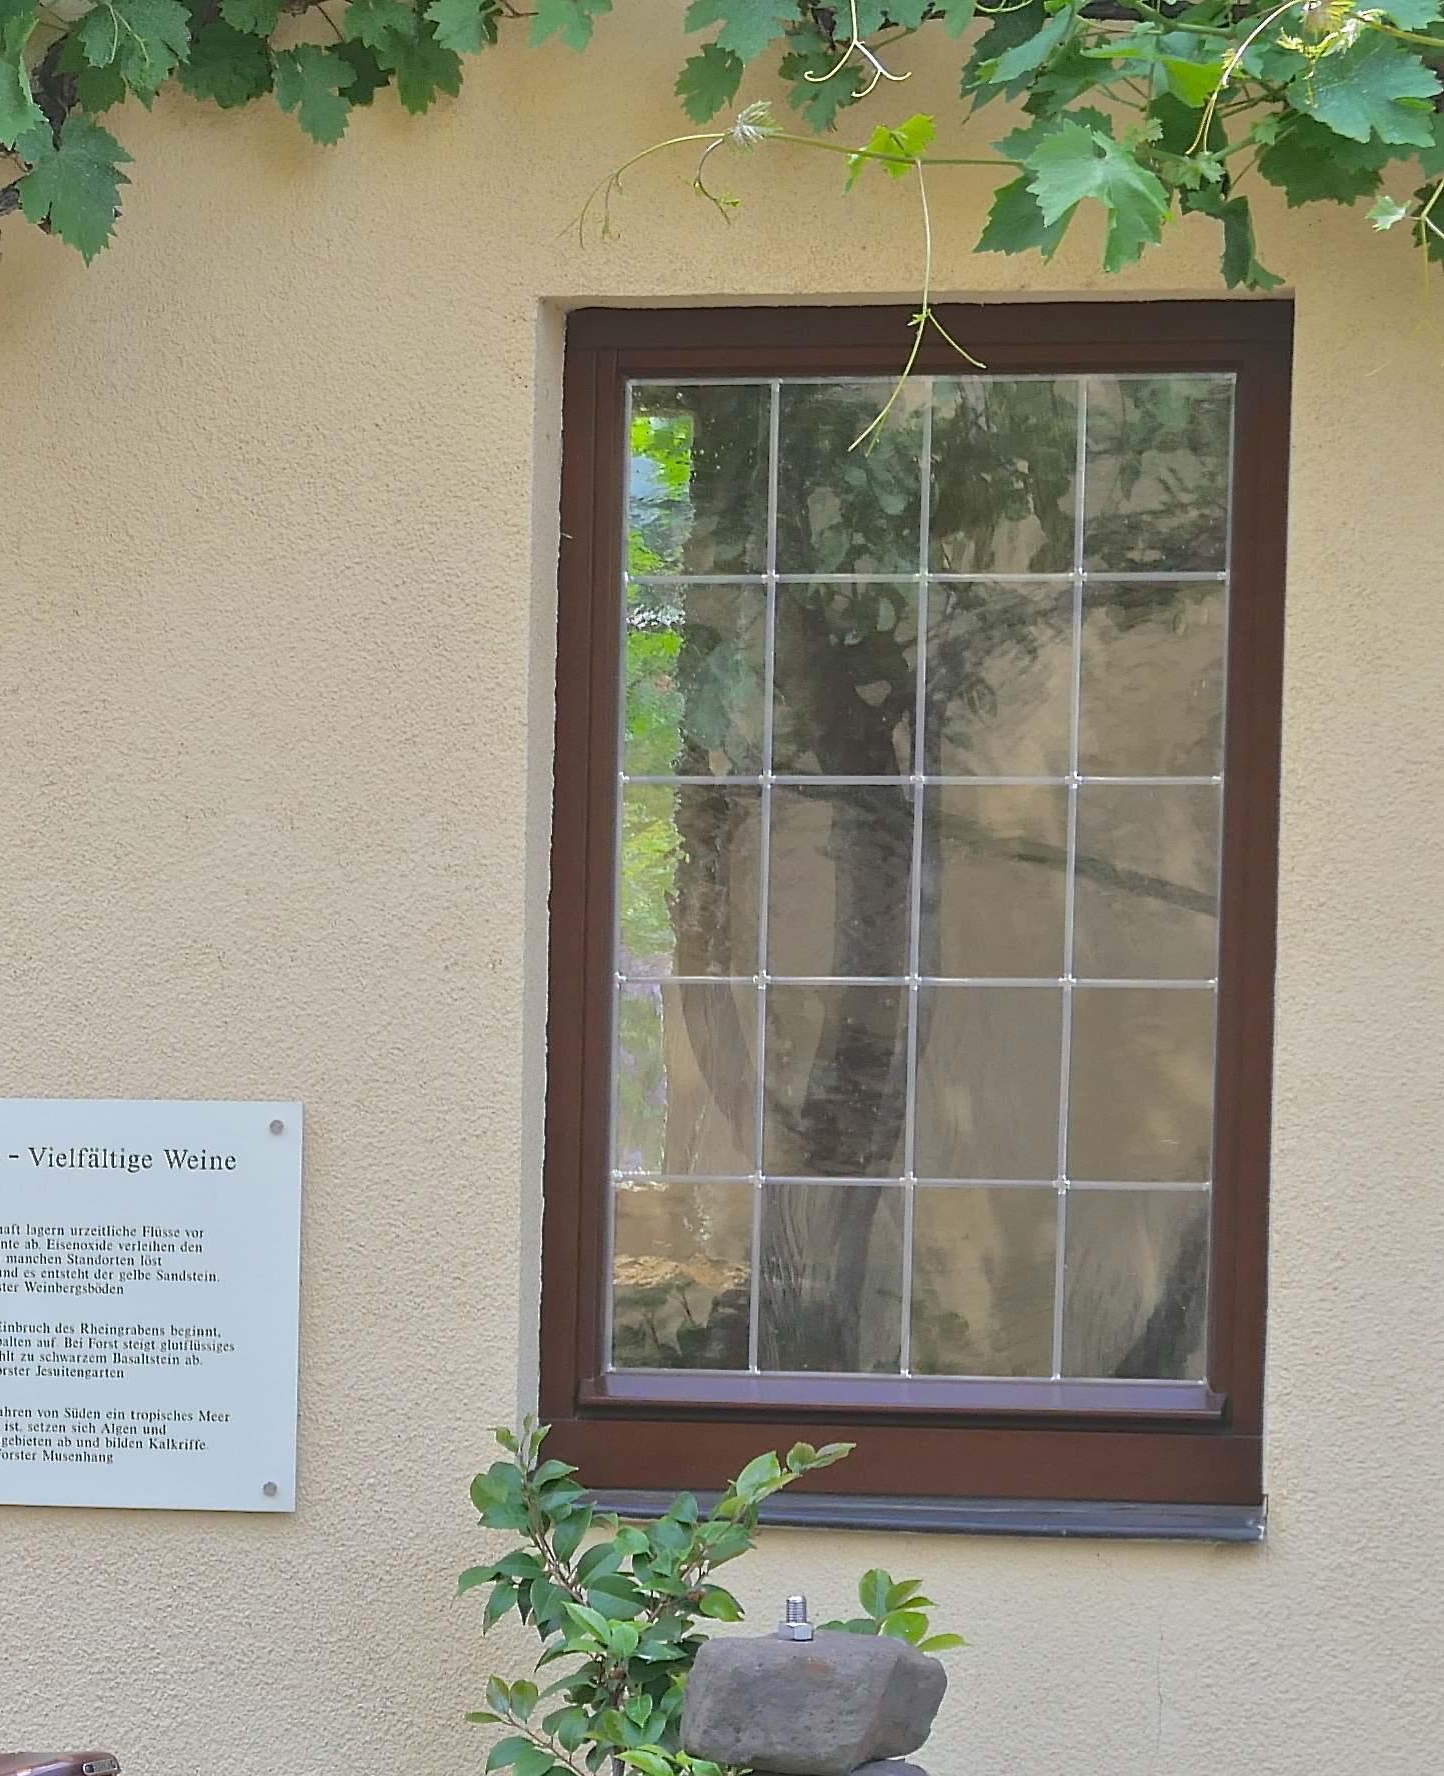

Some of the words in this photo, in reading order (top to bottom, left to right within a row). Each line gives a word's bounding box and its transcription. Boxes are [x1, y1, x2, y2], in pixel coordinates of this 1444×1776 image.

[28, 1147, 152, 1173] Vielfältige
[163, 1149, 236, 1170] Weine
[27, 1224, 64, 1237] lagern
[70, 1225, 136, 1237] urzeitliche
[143, 1226, 179, 1238] Flüsse
[185, 1229, 204, 1238] vor
[45, 1238, 113, 1251] Eisenoxide
[119, 1240, 174, 1252] verleihen
[180, 1241, 202, 1253] den
[6, 1253, 61, 1264] manchen
[67, 1254, 134, 1266] Standorten
[141, 1255, 161, 1266] löst
[23, 1270, 35, 1278] es
[41, 1268, 88, 1279] entsteht
[94, 1268, 114, 1280] der
[119, 1269, 151, 1282] gelbe
[156, 1270, 219, 1282] Sandstein.
[24, 1281, 123, 1296] Weinbergsböden
[55, 1323, 74, 1334] des
[81, 1323, 165, 1337] Rheingrabens
[65, 1337, 82, 1349] Bei
[89, 1337, 117, 1349] Forst
[123, 1338, 154, 1351] steigt
[20, 1353, 34, 1362] zu
[40, 1351, 106, 1364] schwarzem
[111, 1351, 179, 1365] Basaltstein
[35, 1365, 124, 1380] Jesuitengarten
[37, 1409, 58, 1418] von
[64, 1407, 100, 1419] Süden
[106, 1408, 125, 1420] ein
[131, 1409, 193, 1422] tropisches
[199, 1410, 230, 1422] Meer
[28, 1423, 65, 1433] setzen
[71, 1422, 95, 1434] sich
[101, 1423, 137, 1436] Algen
[143, 1421, 166, 1435] und
[57, 1436, 71, 1447] ab
[77, 1437, 99, 1448] und
[105, 1437, 142, 1449] bilden
[43, 1449, 113, 1465] Musenhang
